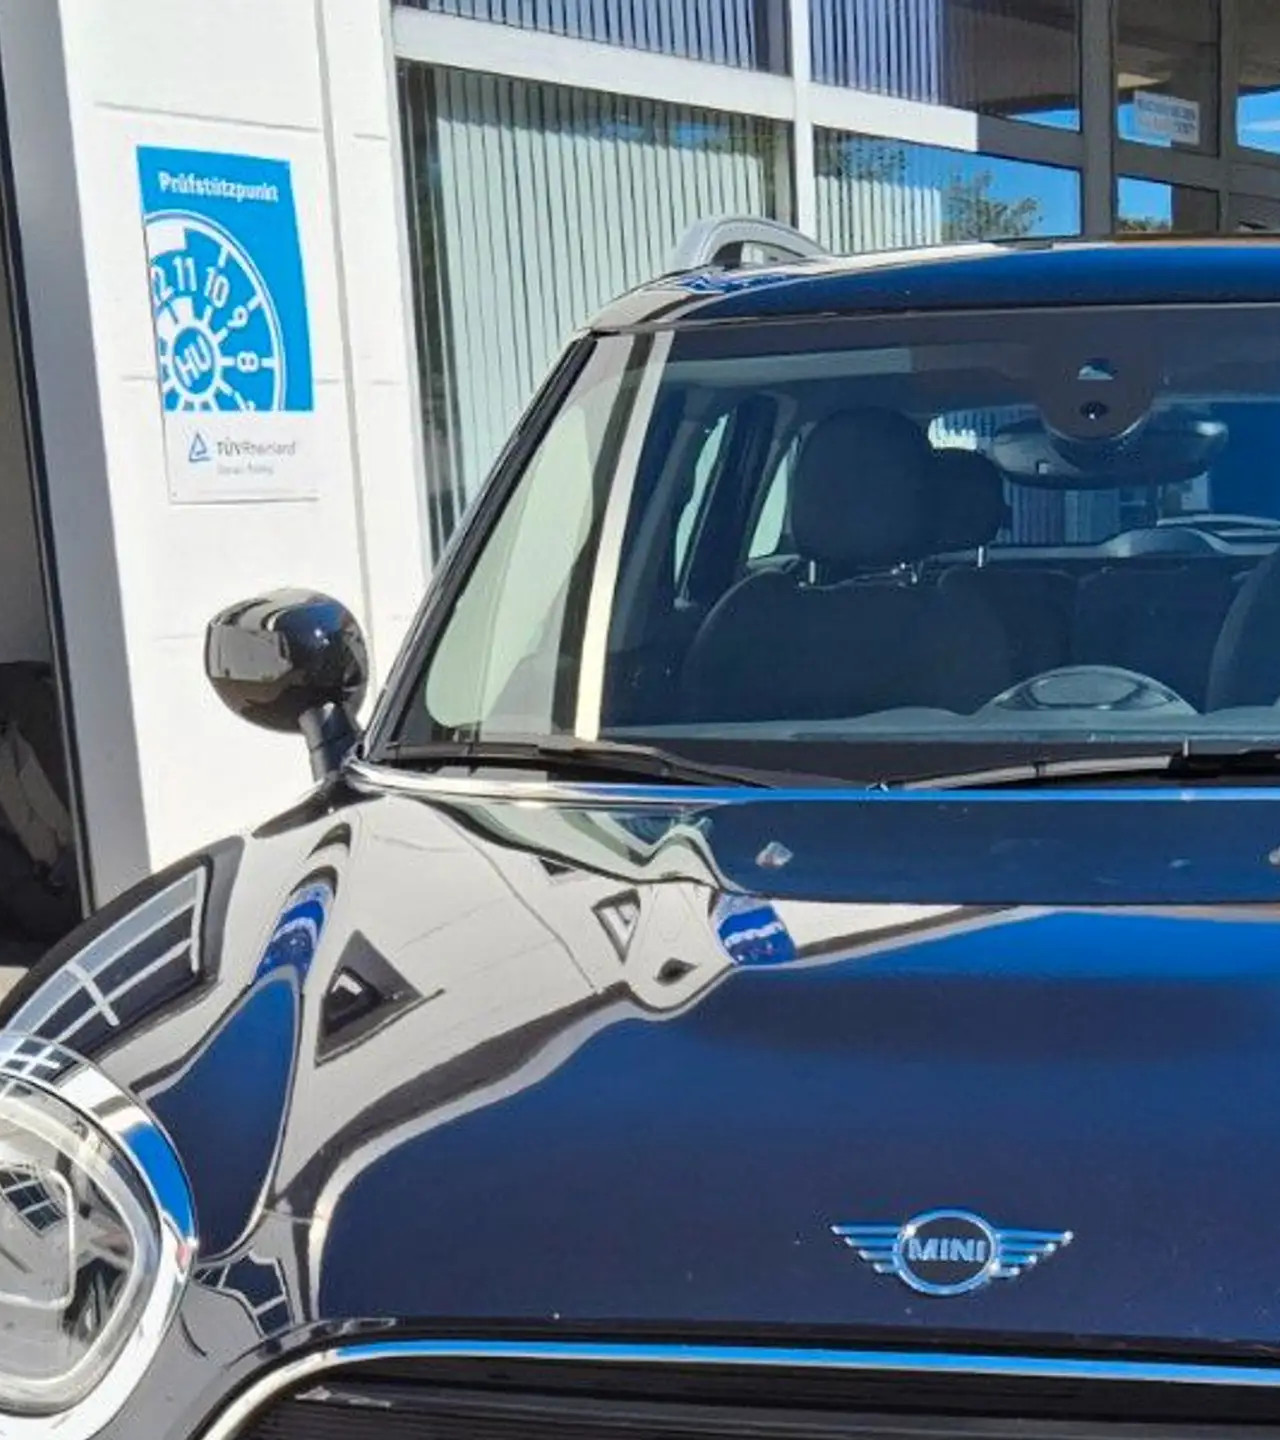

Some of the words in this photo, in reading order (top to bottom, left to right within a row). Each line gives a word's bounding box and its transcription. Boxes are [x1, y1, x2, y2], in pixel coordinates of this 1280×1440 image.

[172, 256, 197, 291] 11
[203, 265, 230, 308] 10
[174, 332, 212, 387] HU
[236, 351, 260, 373] 8
[907, 1237, 987, 1262] MINI
